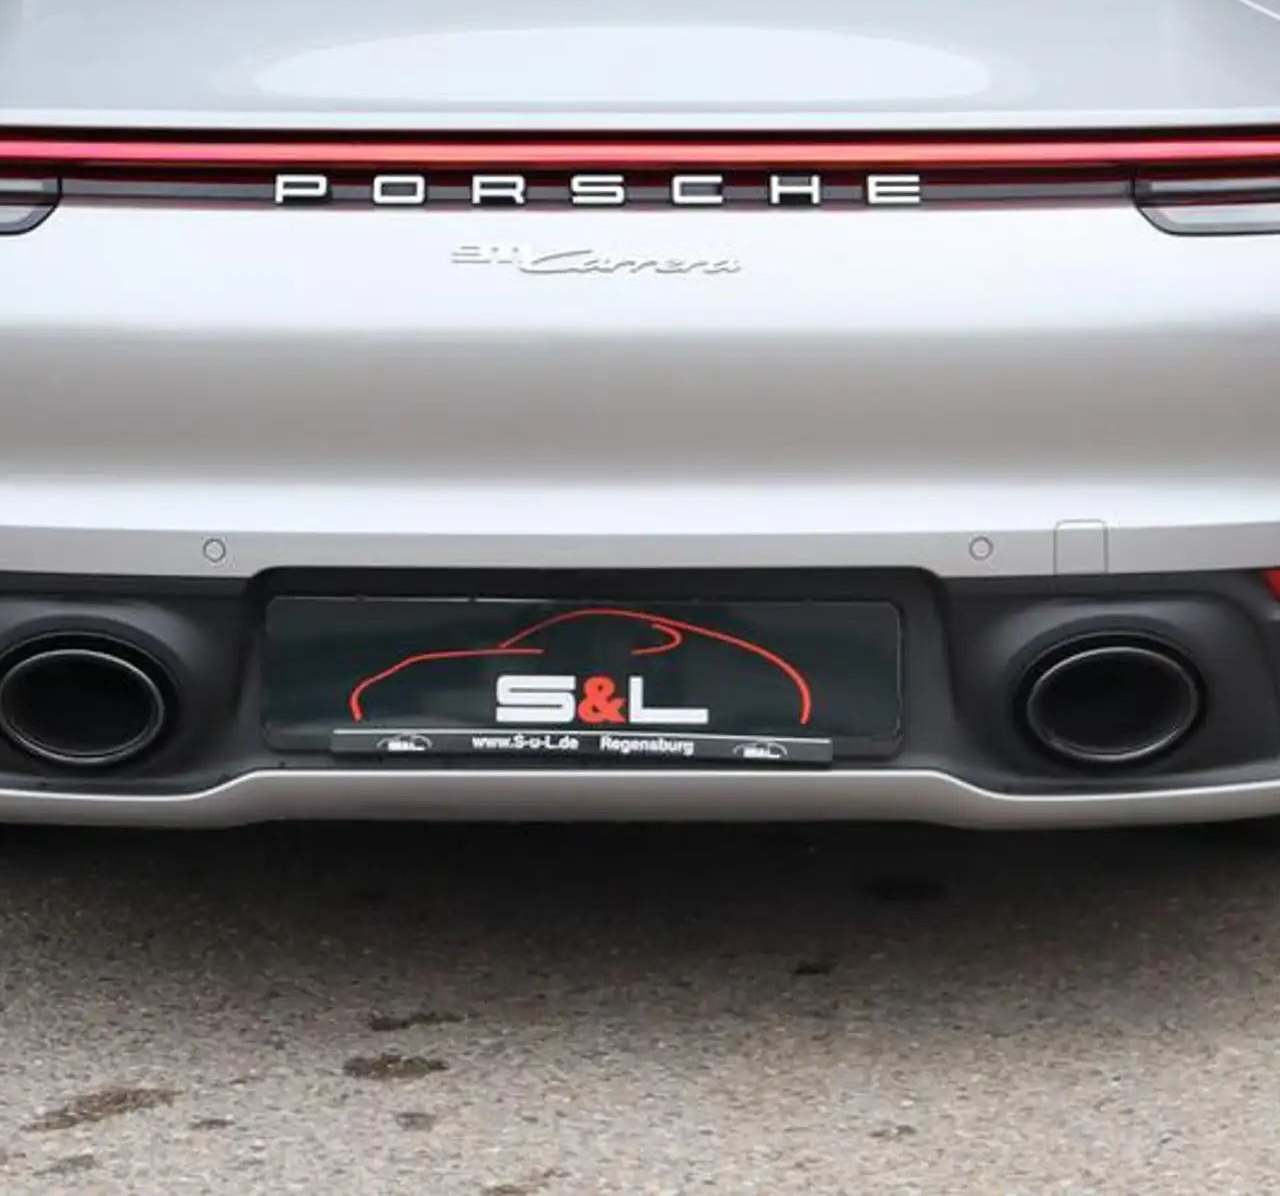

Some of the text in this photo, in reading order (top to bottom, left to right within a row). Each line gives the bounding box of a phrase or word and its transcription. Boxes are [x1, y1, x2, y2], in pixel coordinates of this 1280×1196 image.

[275, 175, 921, 204] PORSCHE
[520, 248, 741, 275] Carrera
[496, 675, 709, 724] S&L
[599, 735, 695, 756] Regensburg
